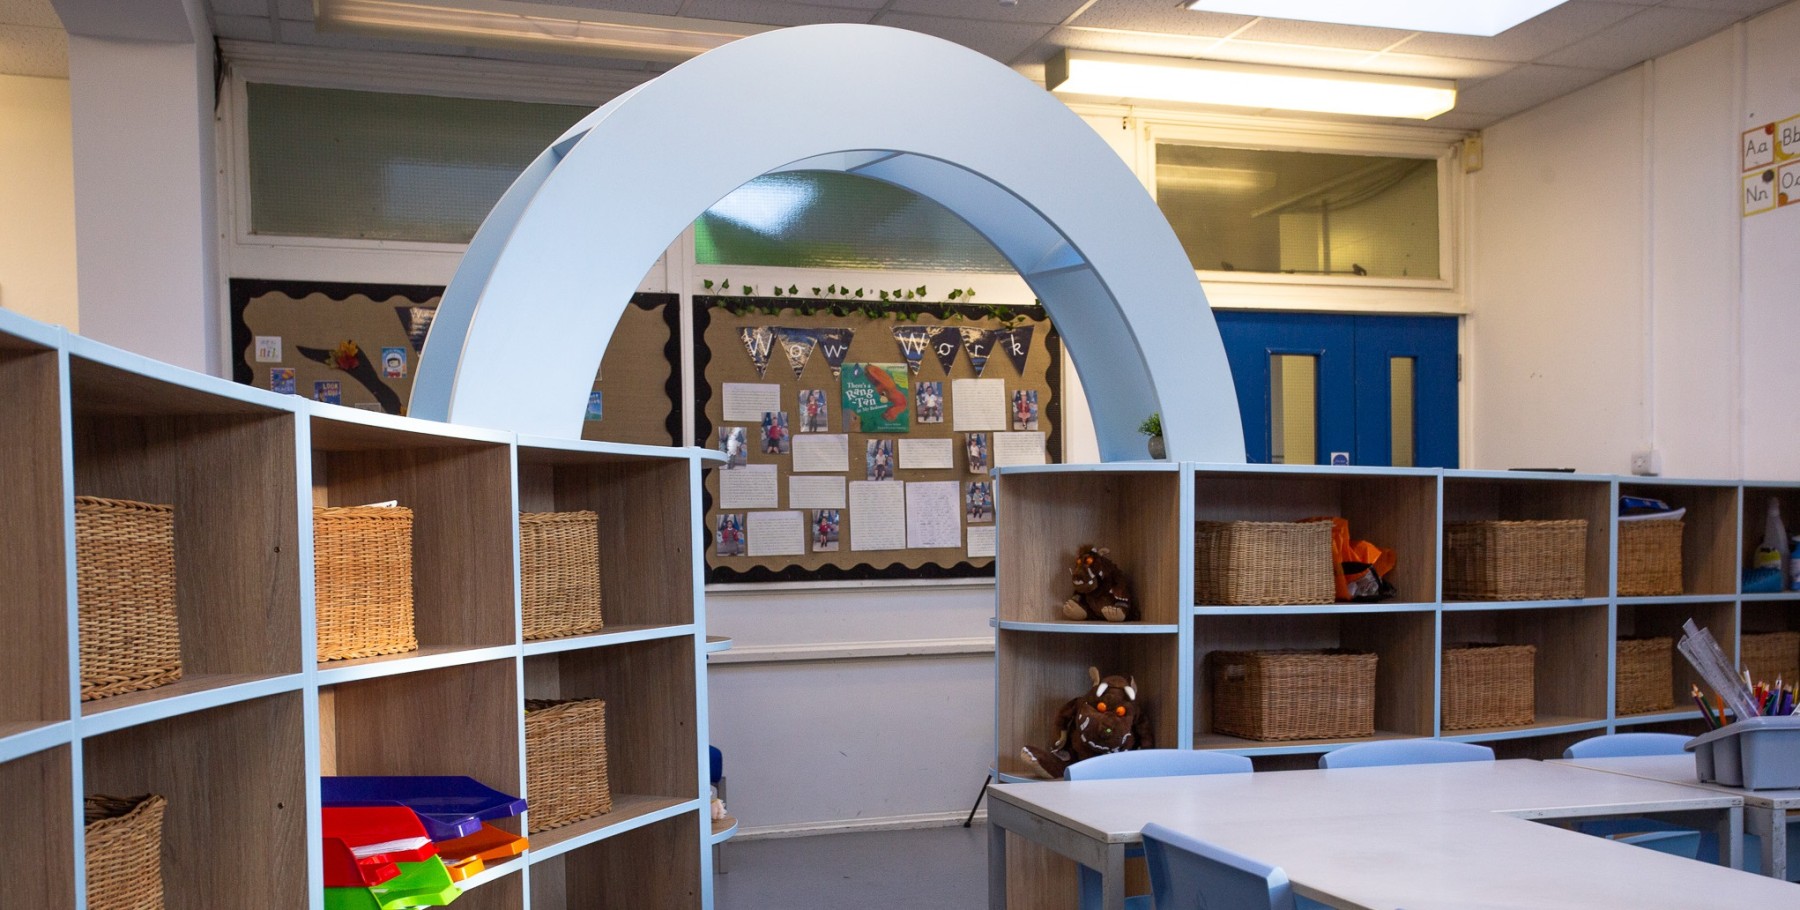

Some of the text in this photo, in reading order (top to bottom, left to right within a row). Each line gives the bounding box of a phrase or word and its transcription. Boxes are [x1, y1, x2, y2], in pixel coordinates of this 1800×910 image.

[1746, 139, 1768, 157] Aa
[1746, 185, 1768, 204] Nn
[898, 332, 1025, 356] Work
[846, 388, 874, 400] Rang
